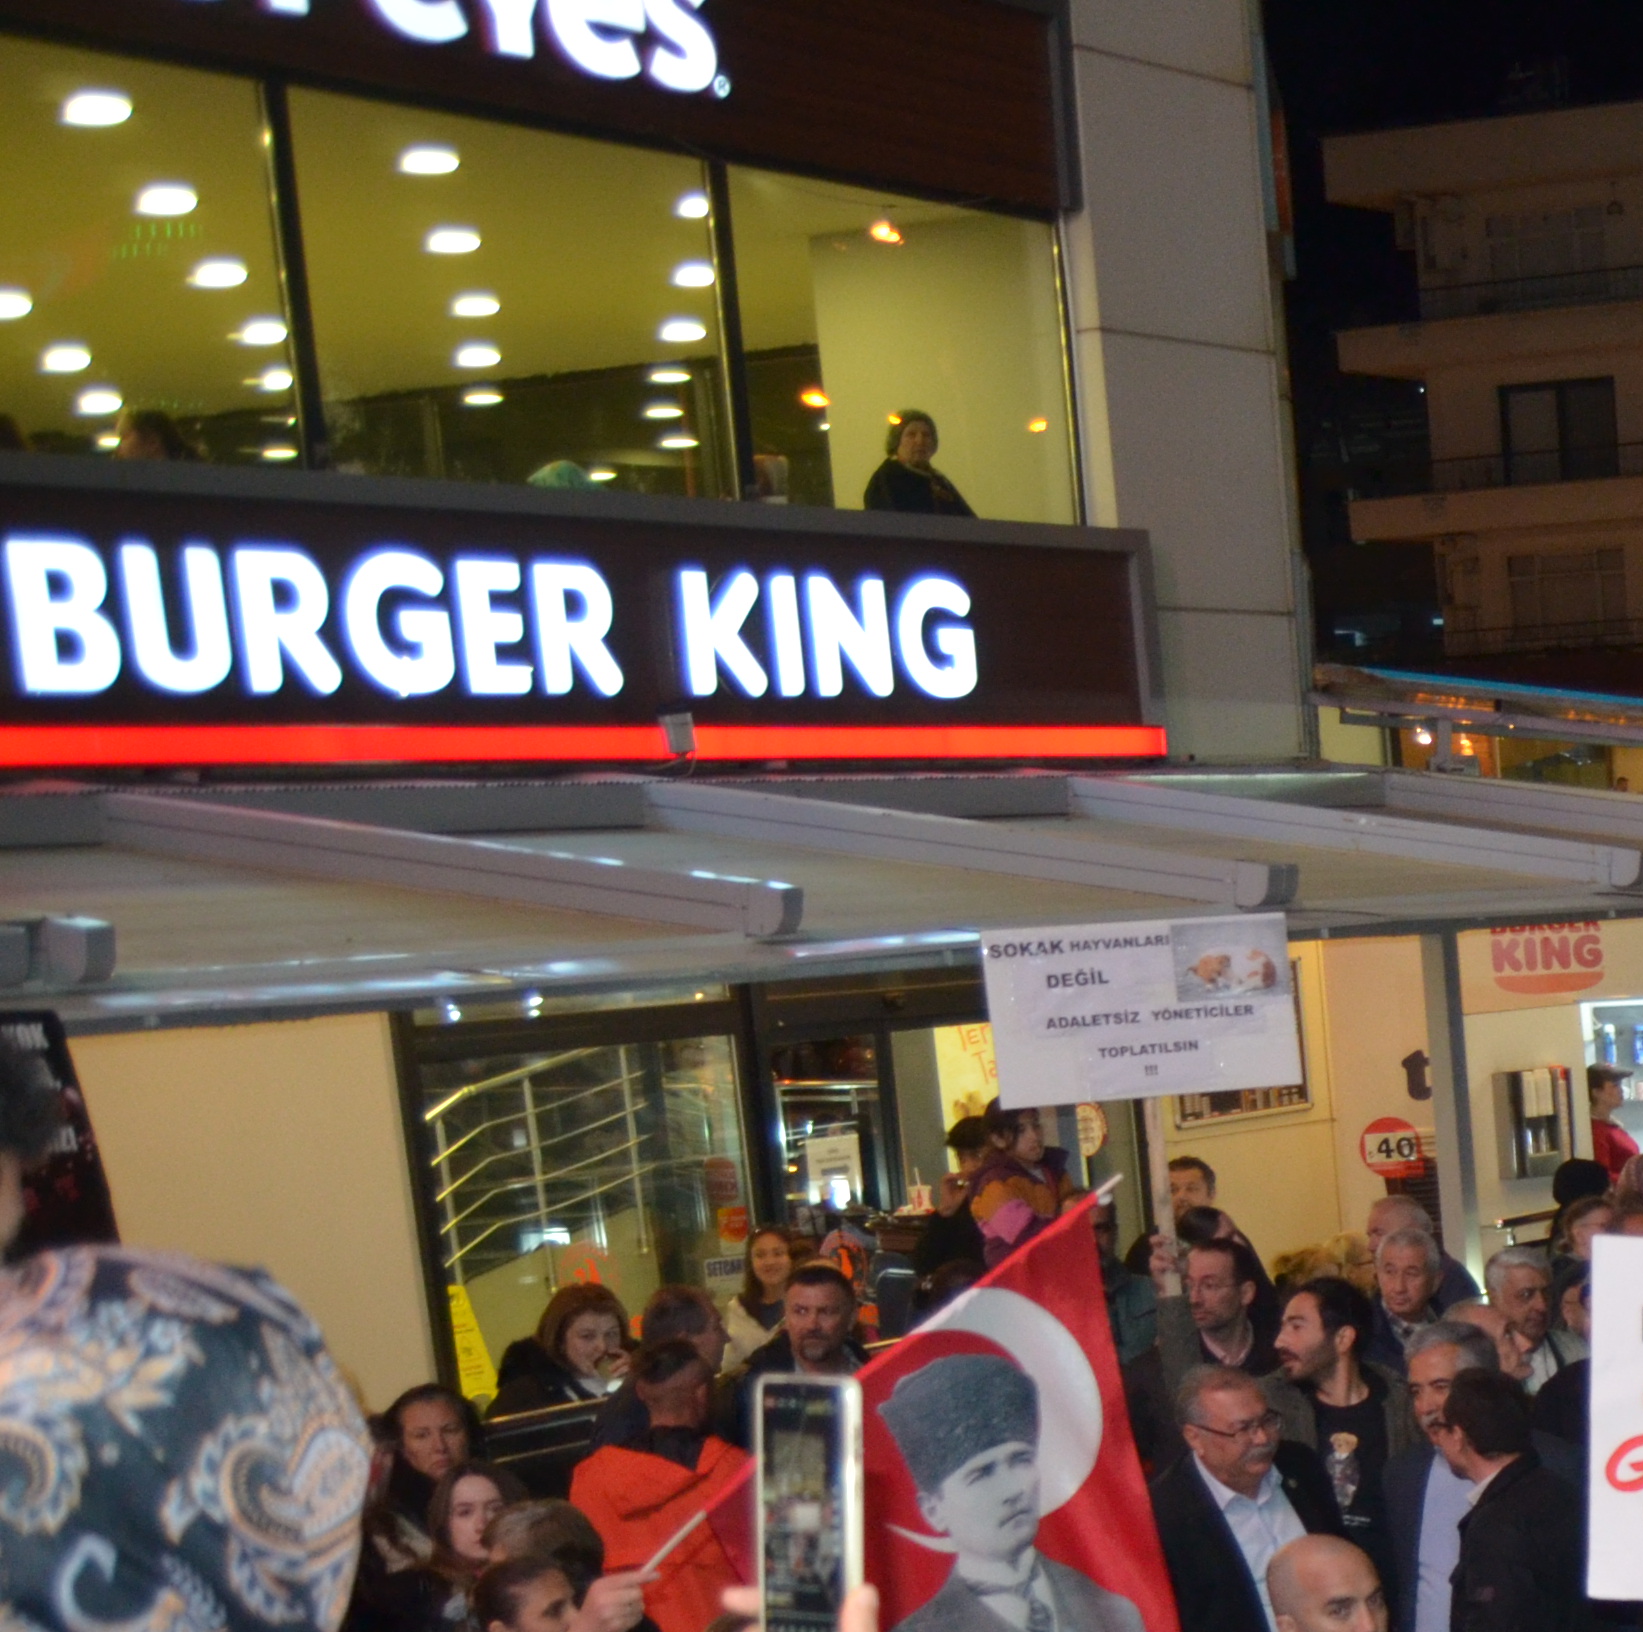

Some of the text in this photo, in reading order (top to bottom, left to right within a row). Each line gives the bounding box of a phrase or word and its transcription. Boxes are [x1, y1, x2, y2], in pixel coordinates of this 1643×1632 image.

[5, 537, 980, 701] BURGER KING
[990, 933, 1170, 960] SOKAK HAYVANLARI
[1491, 934, 1604, 974] KING
[1046, 967, 1109, 990] DEĞİL
[1046, 1003, 1254, 1031] ADALETSİZ YÖNETİCİLER
[1098, 1040, 1199, 1059] TOPLATILSIN
[1377, 1136, 1416, 1159] 40
